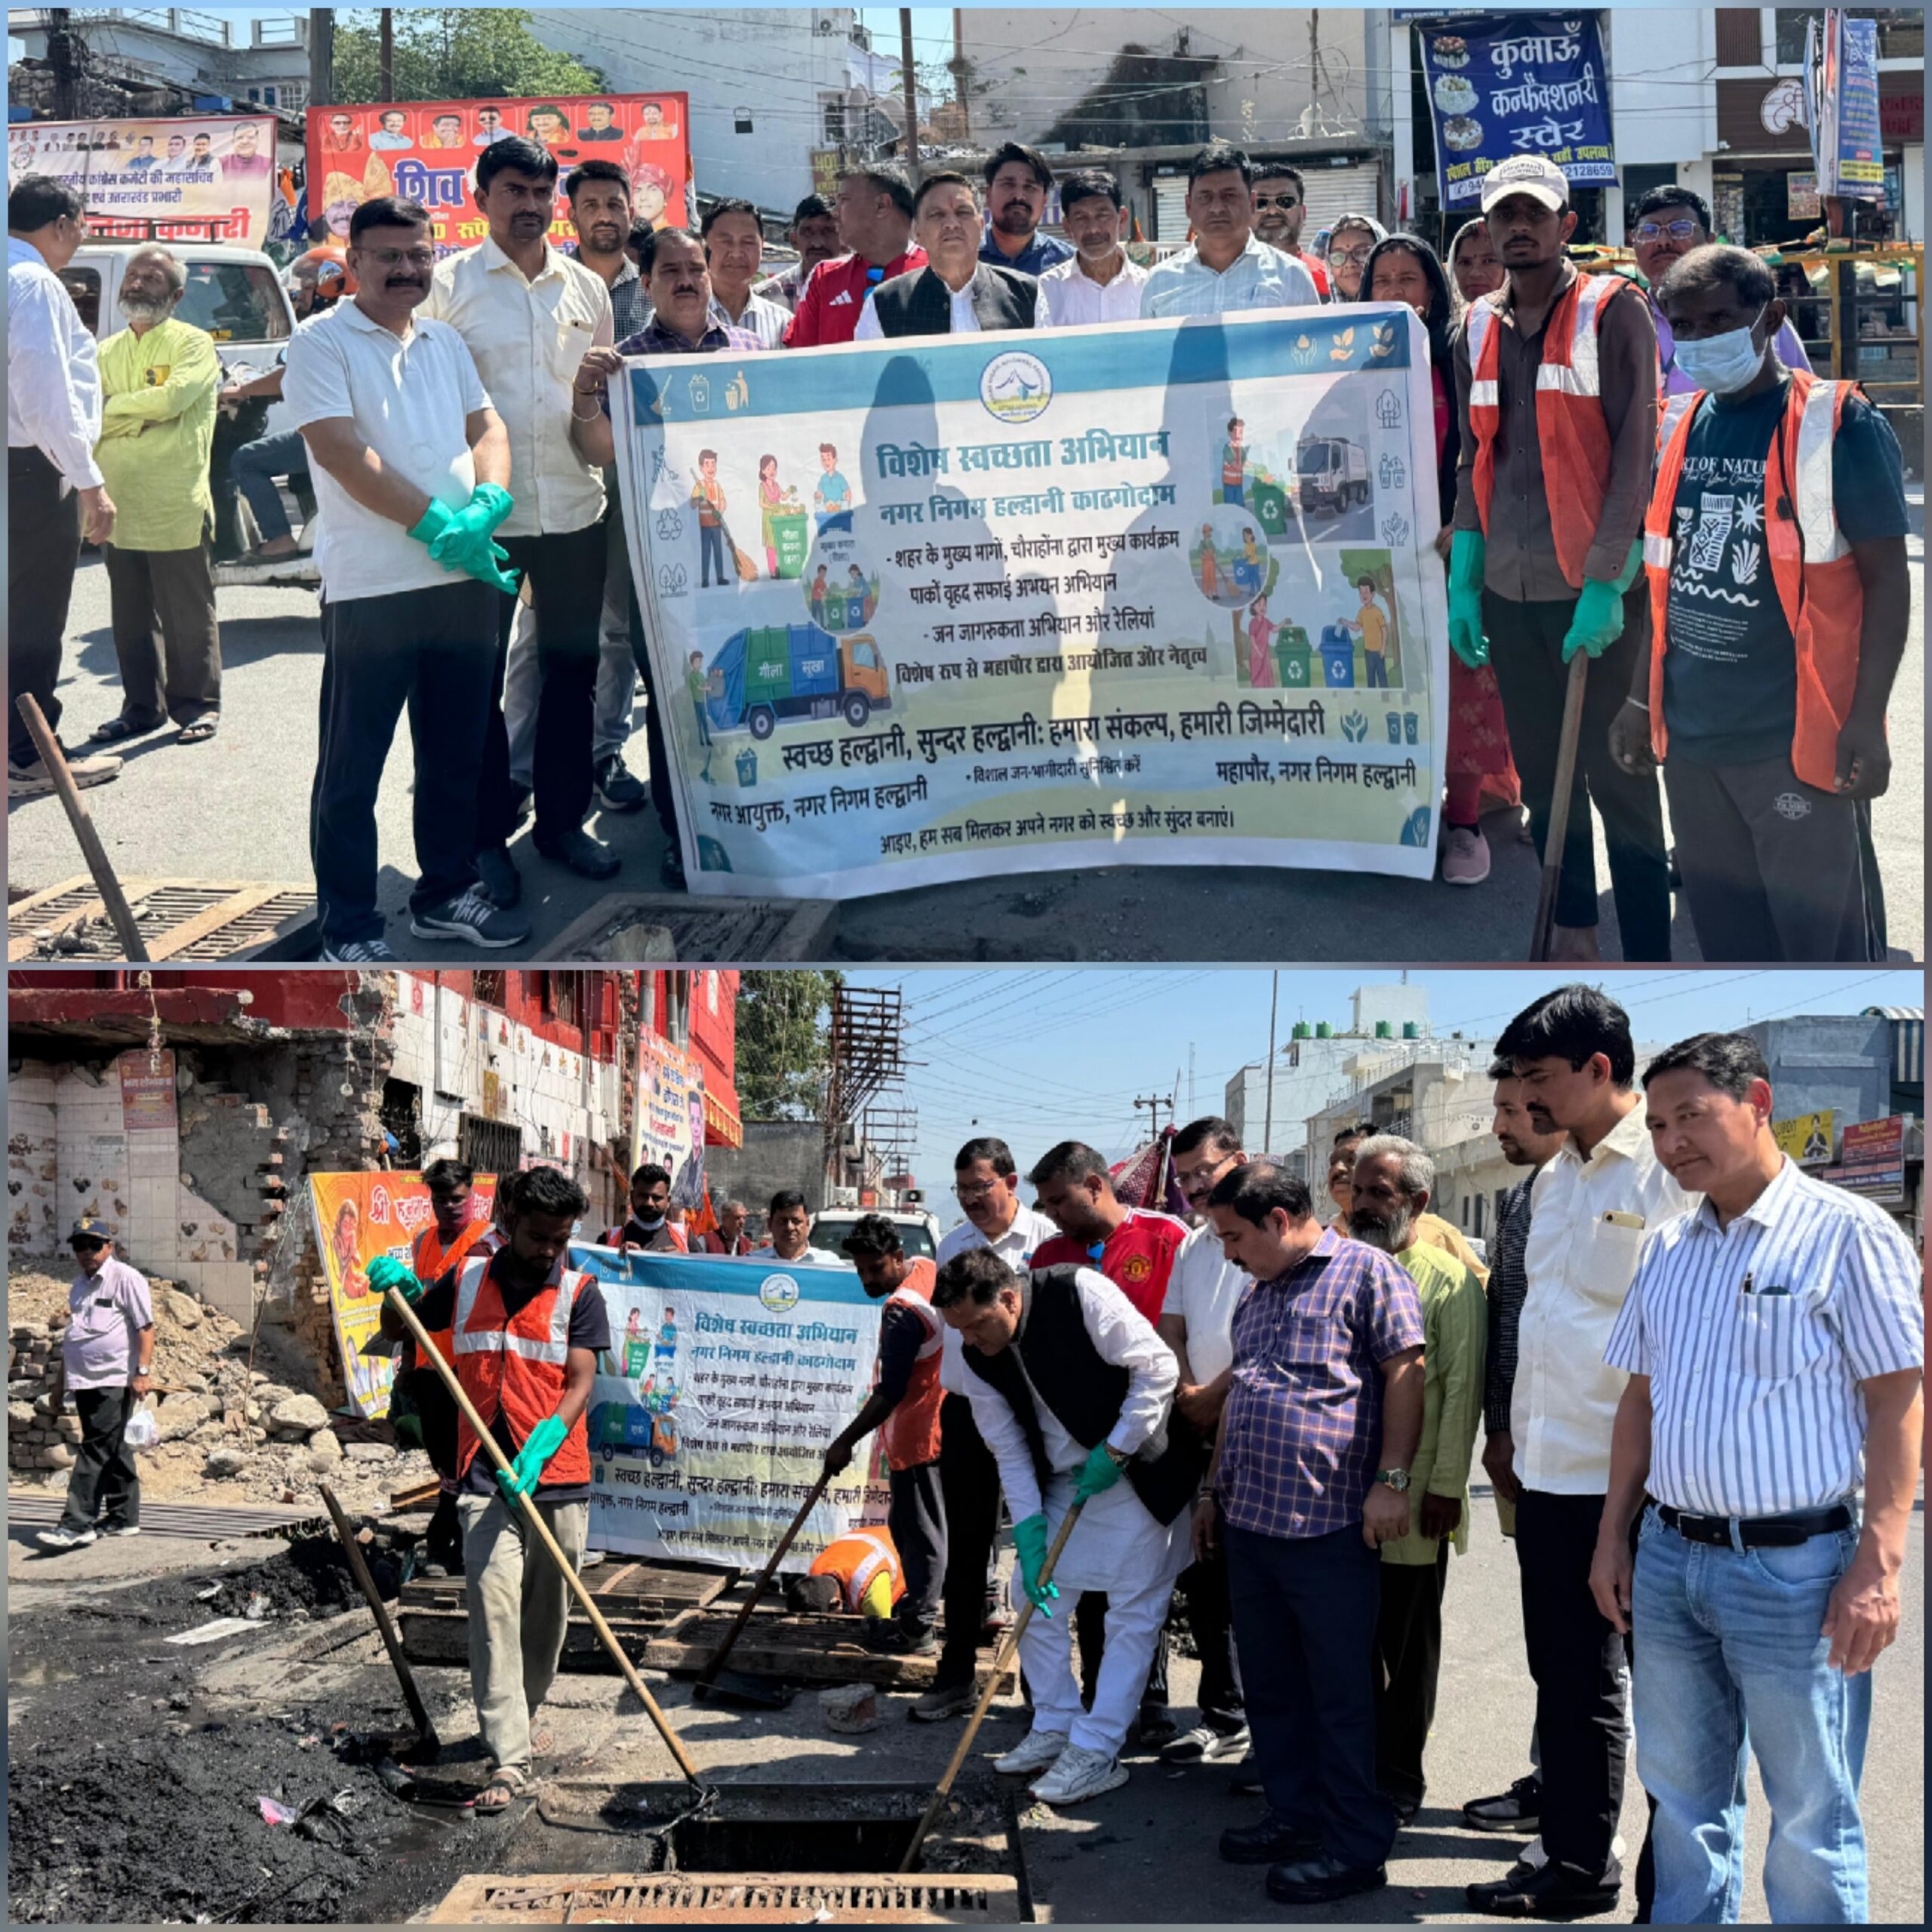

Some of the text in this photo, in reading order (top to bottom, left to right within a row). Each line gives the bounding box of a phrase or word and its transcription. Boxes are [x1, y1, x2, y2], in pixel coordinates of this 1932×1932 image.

[875, 428, 1171, 478] विशेष स्वच्छता अभियान
[1699, 457, 1719, 472] OF
[878, 503, 924, 525] नगर
[929, 494, 986, 523] निगम
[895, 549, 923, 569] शहर
[925, 542, 940, 565] के
[942, 545, 972, 570] मुख्य
[1067, 535, 1094, 558] द्वारा
[1096, 534, 1126, 558] मुख्य
[1128, 525, 1180, 550] कार्यक्रम
[943, 583, 971, 610] वृहद
[973, 573, 1013, 602] सफाई
[1063, 568, 1117, 595] अभियान
[932, 623, 955, 643] जन
[1029, 611, 1081, 637] अभियान
[1085, 605, 1111, 632] और
[758, 661, 783, 679] गीला
[801, 659, 825, 678] सूखा
[896, 660, 935, 685] विशेष
[965, 657, 980, 678] से
[983, 654, 1033, 677] महापौर
[1035, 655, 1063, 673] द्वारा
[1067, 648, 1133, 671] आयोजित
[1136, 645, 1164, 667] और
[781, 740, 834, 771] स्वच्छ
[838, 722, 912, 768] हल्द्वानी,
[917, 726, 967, 764] सुन्दर
[1048, 717, 1100, 746] हमारा
[1104, 706, 1175, 742] संकल्प,
[1179, 701, 1232, 740] हमारी
[1238, 699, 1325, 737] जिम्मेदारी
[974, 765, 1008, 784] विशाल
[1216, 752, 1417, 791] महापौर, नगर निगम हल्द्वानी
[735, 800, 791, 832] आयुक्त,
[794, 795, 827, 817] नगर
[830, 786, 870, 814] निगम
[874, 774, 928, 808] हल्द्वानी
[880, 832, 916, 855] आइए,
[919, 829, 938, 851] हम
[941, 825, 963, 845] सब
[965, 818, 1011, 842] मिलकर
[1016, 811, 1045, 837] अपने
[1049, 815, 1075, 833] नगर
[1078, 808, 1097, 831] को
[1099, 813, 1135, 830] स्वच्छ
[1137, 804, 1161, 829] और
[1164, 805, 1192, 833] सुंदर
[695, 1311, 858, 1344] विशेष स्वच्छता अभियान
[691, 1345, 715, 1360] नगर
[718, 1345, 751, 1363] निगम
[614, 1467, 641, 1484] स्वच्छ
[687, 1474, 715, 1496] सुन्दर
[760, 1481, 789, 1500] हमारा
[834, 1484, 861, 1506] हमारी
